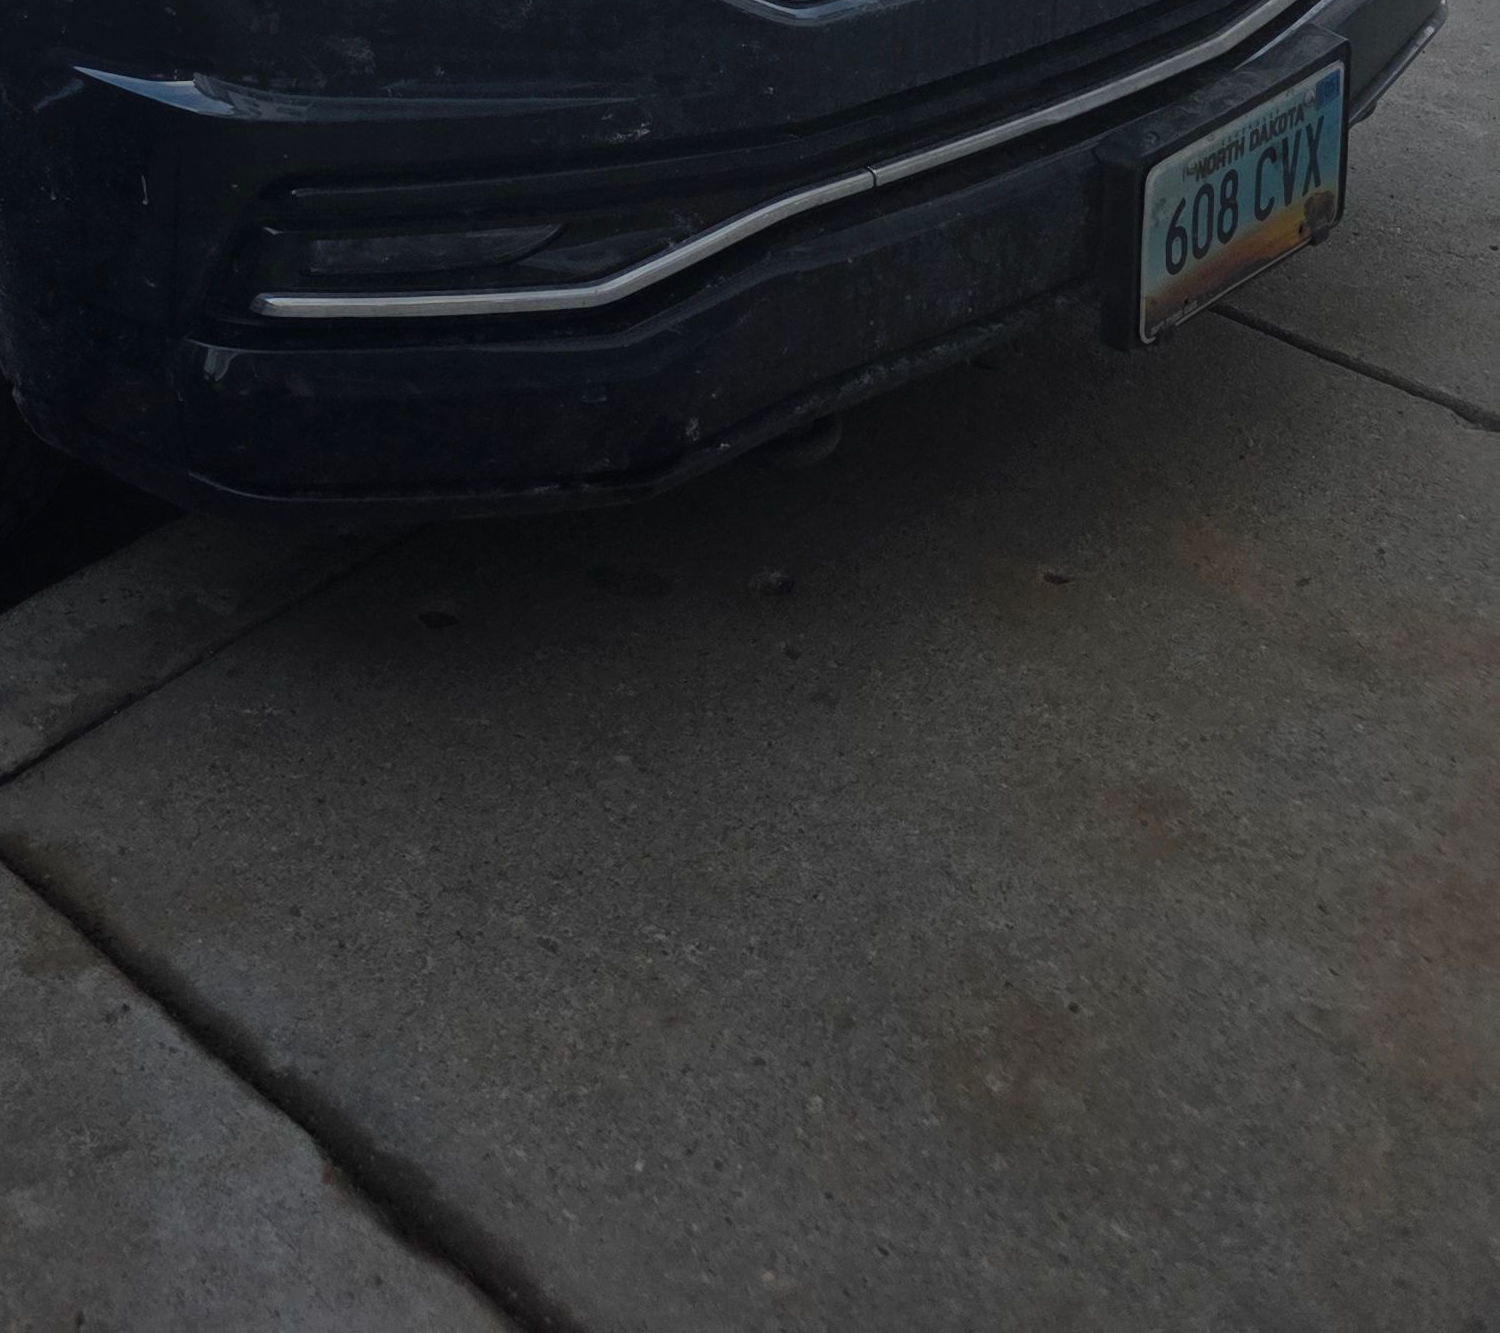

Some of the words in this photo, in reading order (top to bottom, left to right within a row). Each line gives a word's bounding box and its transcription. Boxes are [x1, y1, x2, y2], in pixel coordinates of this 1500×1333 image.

[1165, 167, 1239, 275] 608
[1254, 115, 1325, 222] CVX
[1195, 141, 1245, 182] NORTH
[1249, 102, 1304, 153] DAKOTA
